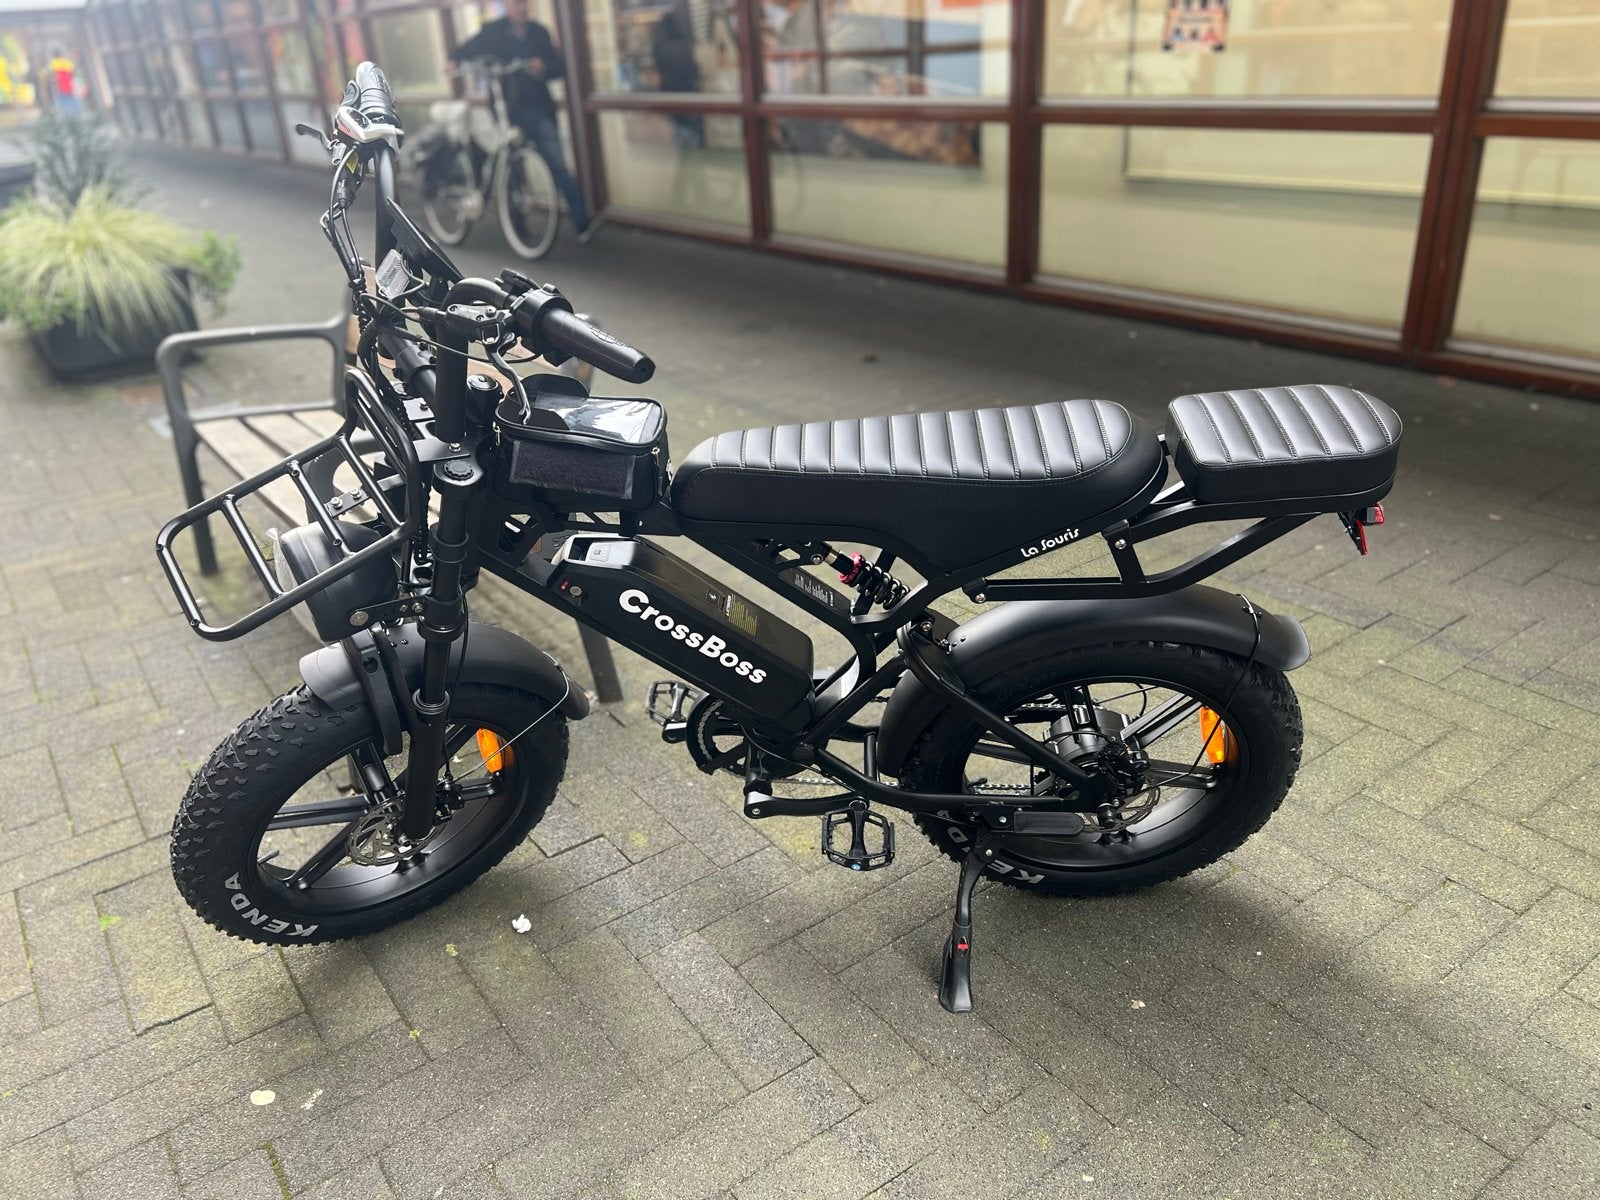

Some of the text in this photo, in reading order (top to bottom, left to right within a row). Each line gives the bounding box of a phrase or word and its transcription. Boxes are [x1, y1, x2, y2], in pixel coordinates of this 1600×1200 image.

[1020, 528, 1080, 558] La Souris
[619, 589, 767, 684] CrossBoss
[224, 871, 320, 937] KENDA
